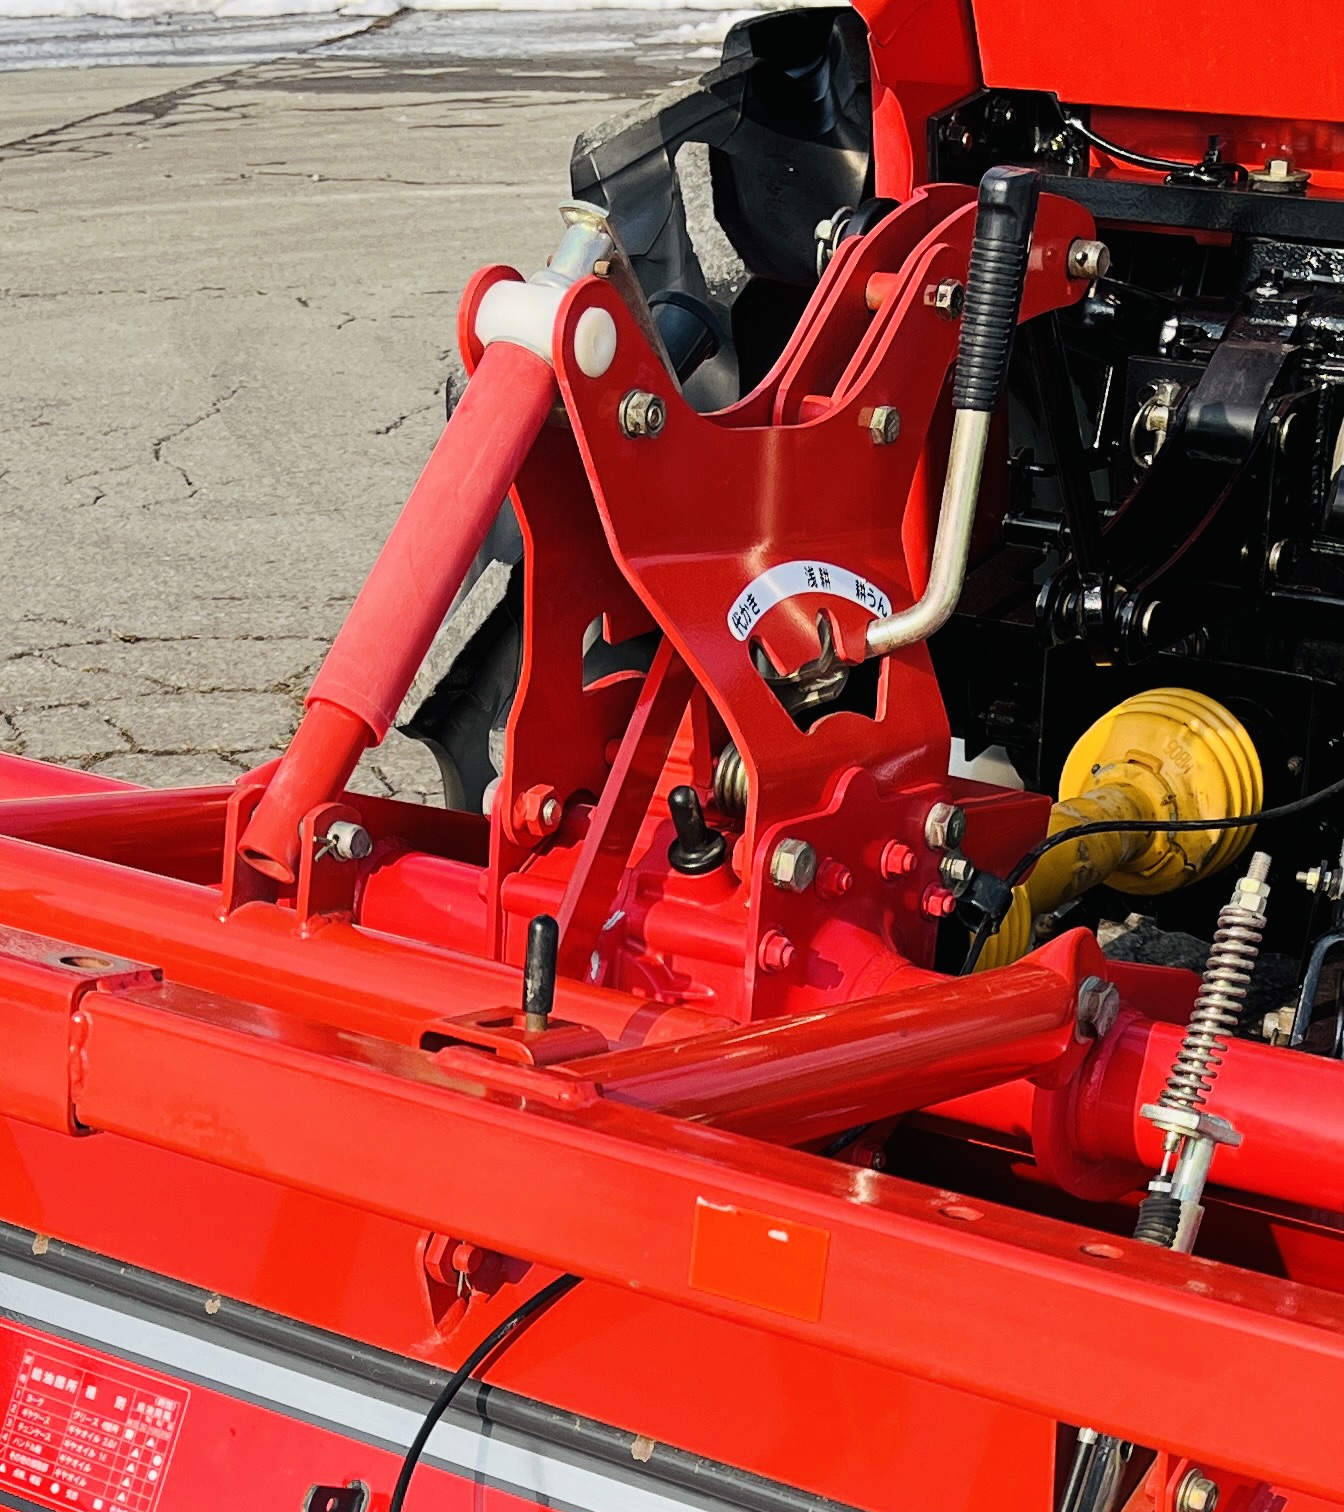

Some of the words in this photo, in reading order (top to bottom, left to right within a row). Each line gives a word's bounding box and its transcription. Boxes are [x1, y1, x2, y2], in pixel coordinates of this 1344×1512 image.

[732, 592, 762, 638] 代かき
[855, 578, 889, 618] 耕うん
